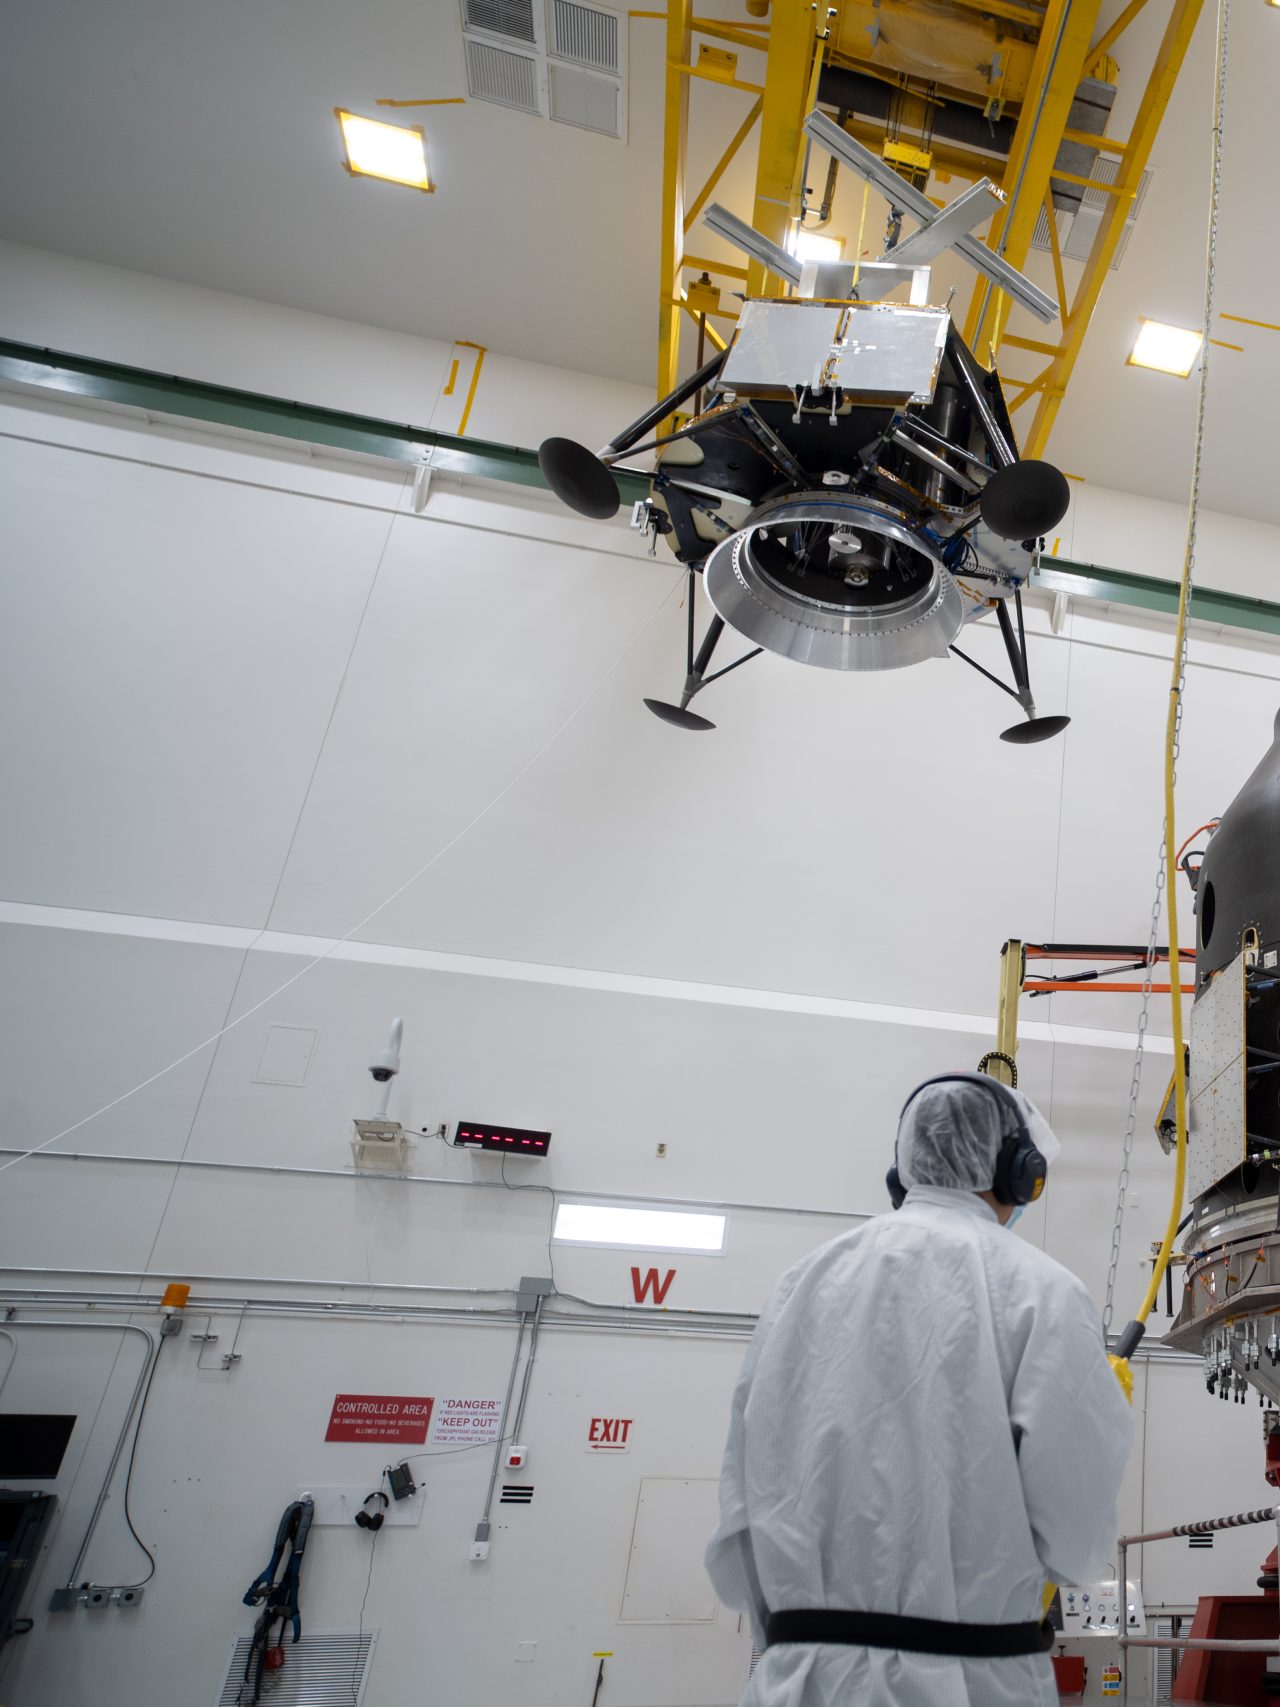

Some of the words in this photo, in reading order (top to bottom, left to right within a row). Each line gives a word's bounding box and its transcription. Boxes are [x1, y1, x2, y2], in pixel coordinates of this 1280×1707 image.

[631, 1267, 677, 1304] W
[336, 1402, 399, 1414] CONTROLLED
[402, 1404, 428, 1415] AREA
[588, 1418, 633, 1443] EXIT
